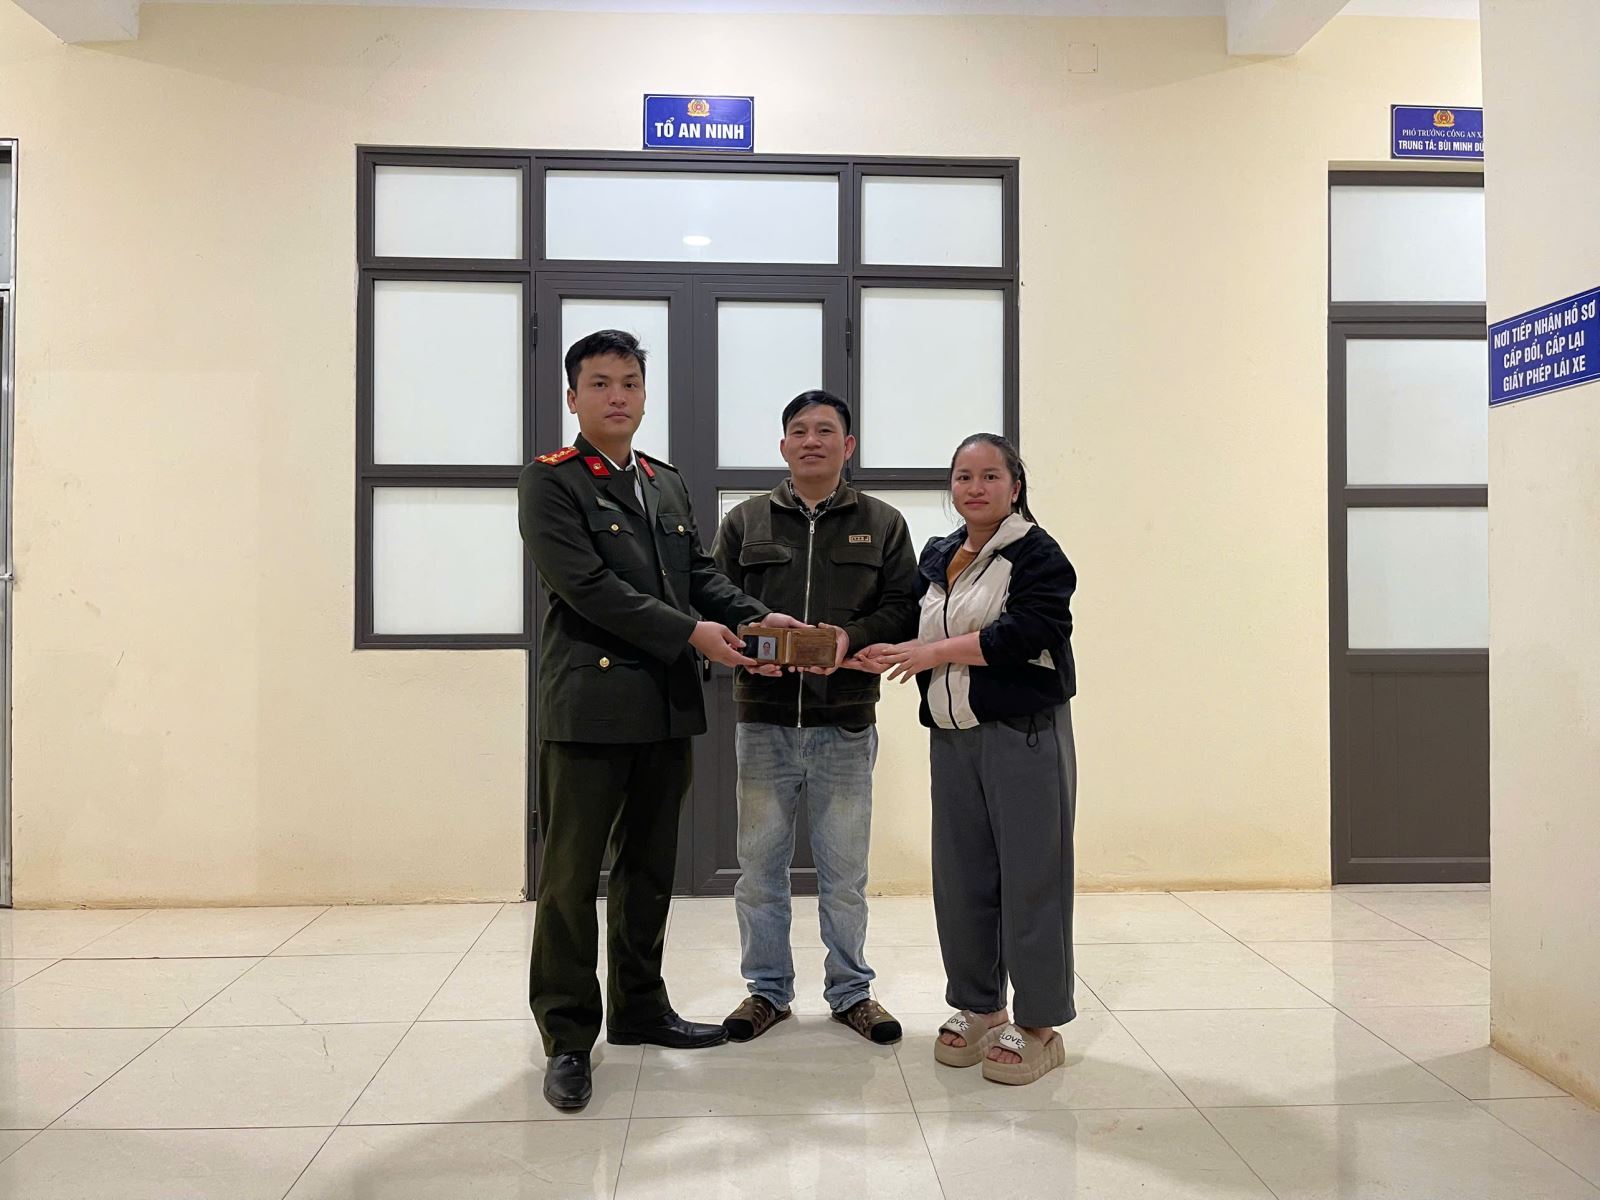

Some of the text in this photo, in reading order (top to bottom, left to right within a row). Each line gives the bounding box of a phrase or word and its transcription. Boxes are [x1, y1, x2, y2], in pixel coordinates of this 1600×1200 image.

[655, 117, 744, 139] TỔ AN NINH
[1402, 128, 1416, 136] PHÓ
[1446, 129, 1465, 138] CÔNG
[1398, 140, 1423, 150] TRUNG
[1425, 139, 1437, 150] TÁ:
[1438, 139, 1451, 151] BÙI
[1453, 141, 1473, 152] MINH
[1494, 299, 1596, 349] NƠI TIẾP NHẬN HỒ SƠ
[1503, 330, 1585, 369] CẤP ĐỔI, CẤP LẠI
[1503, 354, 1586, 392] GIẤY PHÉP LÁI XE
